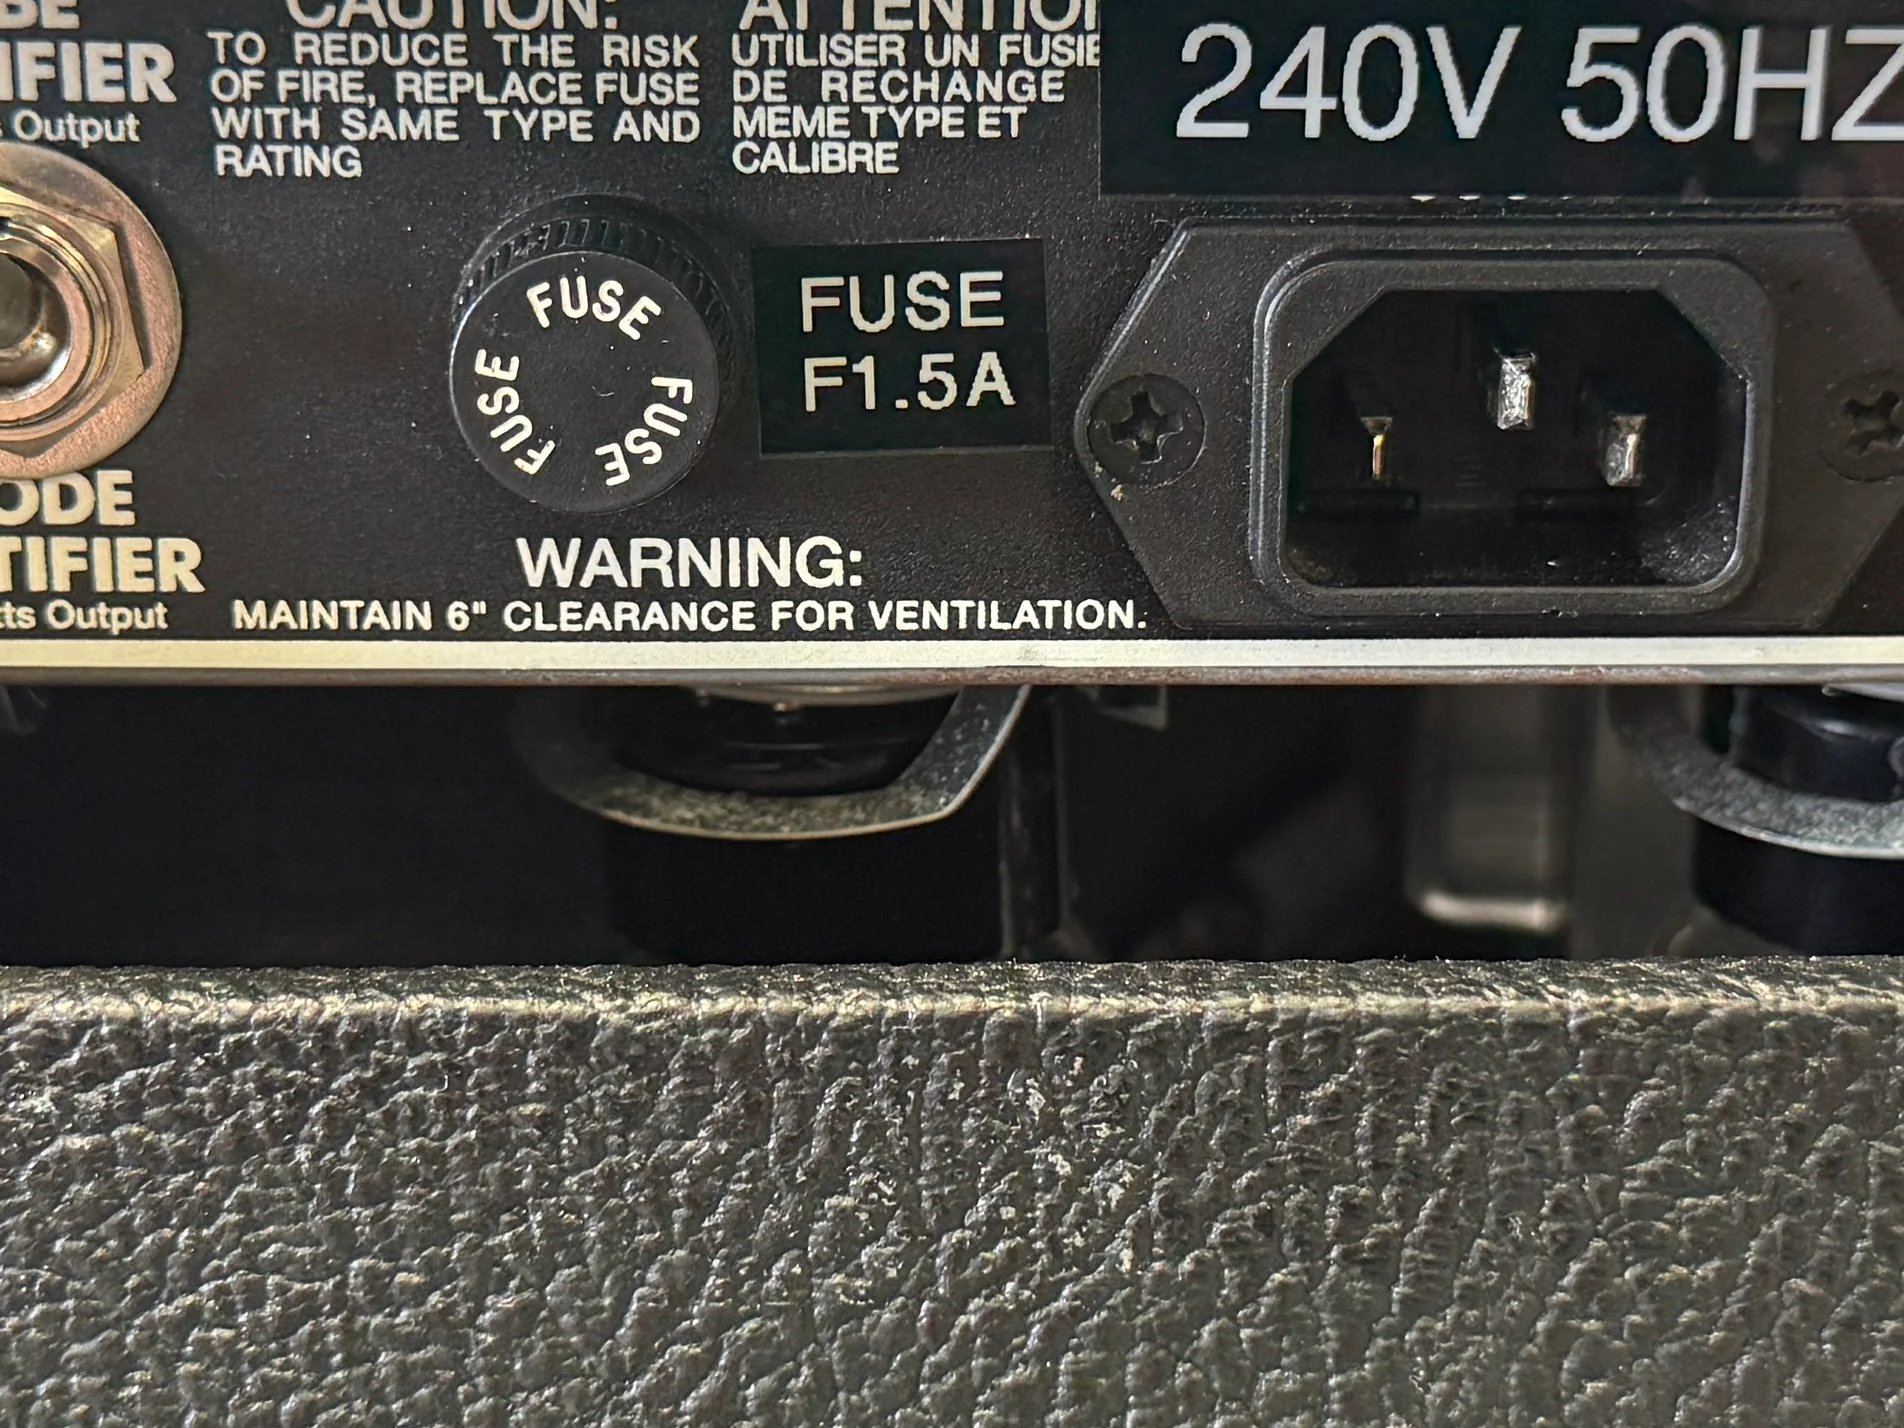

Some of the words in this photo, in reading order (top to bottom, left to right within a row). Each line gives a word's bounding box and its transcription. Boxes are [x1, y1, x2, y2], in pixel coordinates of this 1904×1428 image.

[207, 31, 267, 66] TO
[295, 32, 468, 67] REDUCE
[494, 34, 576, 67] THE
[602, 35, 701, 68] RISK
[731, 33, 906, 68] UTILISER
[924, 34, 979, 68] UN
[210, 70, 264, 103] OF
[278, 70, 376, 109] FIRE,
[396, 71, 582, 105] REPLACE
[596, 72, 700, 106] FUSE
[733, 70, 787, 103] DE
[821, 69, 1065, 103] RECHANGE
[1175, 22, 1523, 141] 240V
[10, 109, 141, 148] Output
[211, 107, 320, 141] WITH
[341, 108, 459, 142] SAME
[484, 109, 593, 142] TYPE
[613, 109, 701, 143] AND
[732, 105, 850, 139] MEME
[861, 105, 965, 139] TYPE
[977, 105, 1028, 139] ET
[215, 144, 362, 178] RATING
[732, 141, 900, 175] CALIBRE
[526, 275, 662, 341] FUSE
[801, 271, 1005, 333] FUSE
[804, 351, 1016, 412] F1.5A
[474, 348, 556, 475] FUSE
[594, 376, 694, 487] FUSE
[515, 536, 863, 589] WARNING:
[46, 602, 168, 635] Output
[231, 599, 440, 632] MAINTAIN
[502, 598, 756, 633] CLEARANCE
[771, 598, 854, 632] FOR
[867, 597, 1147, 632] VENTILATION.
